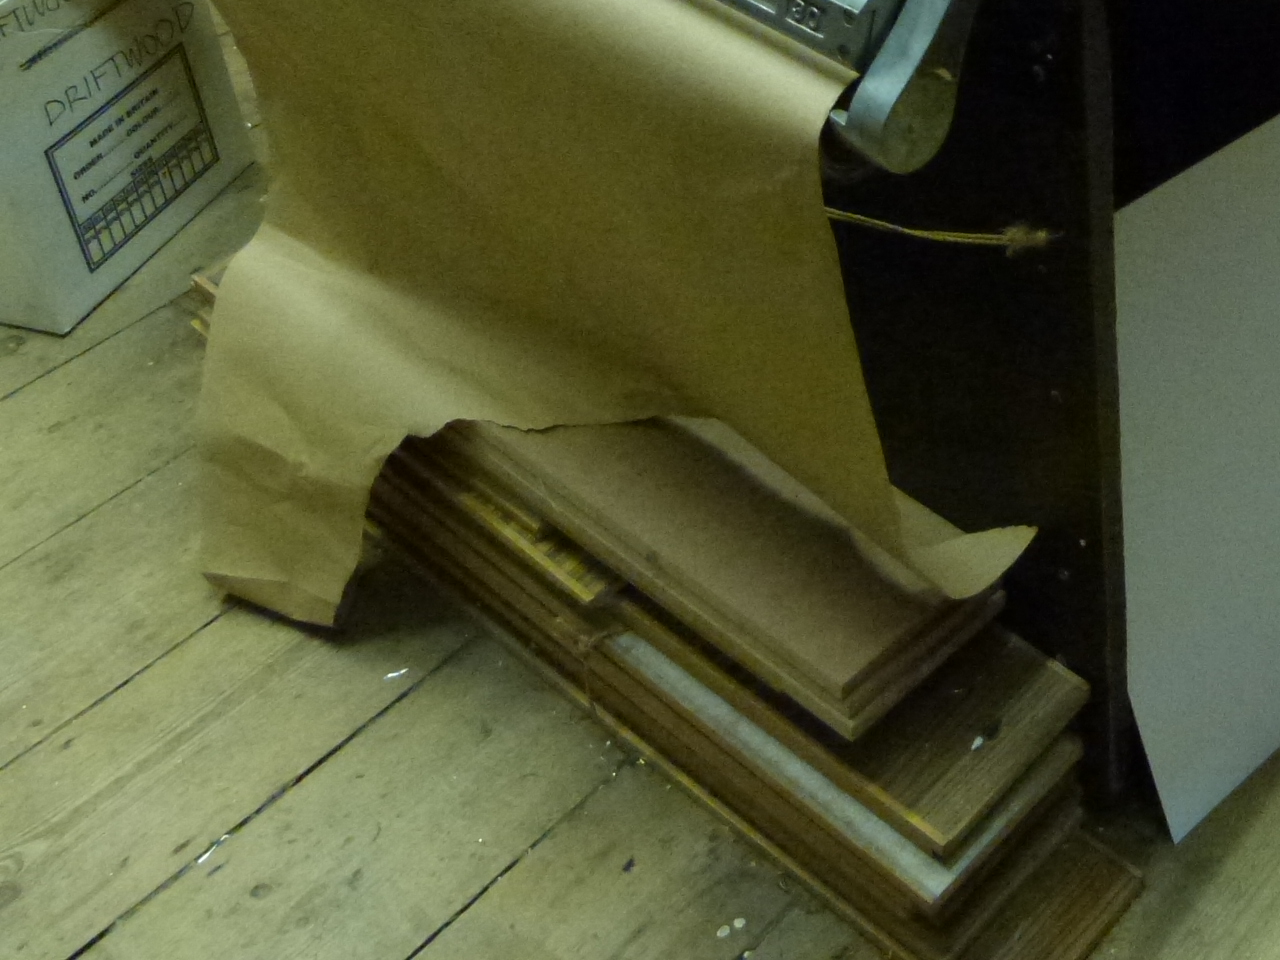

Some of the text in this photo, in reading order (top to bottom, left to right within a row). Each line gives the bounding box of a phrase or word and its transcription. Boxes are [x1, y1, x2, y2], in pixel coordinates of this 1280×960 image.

[43, 1, 195, 127] DRIFTWOOD
[89, 88, 158, 149] MADE IN BRITAIN
